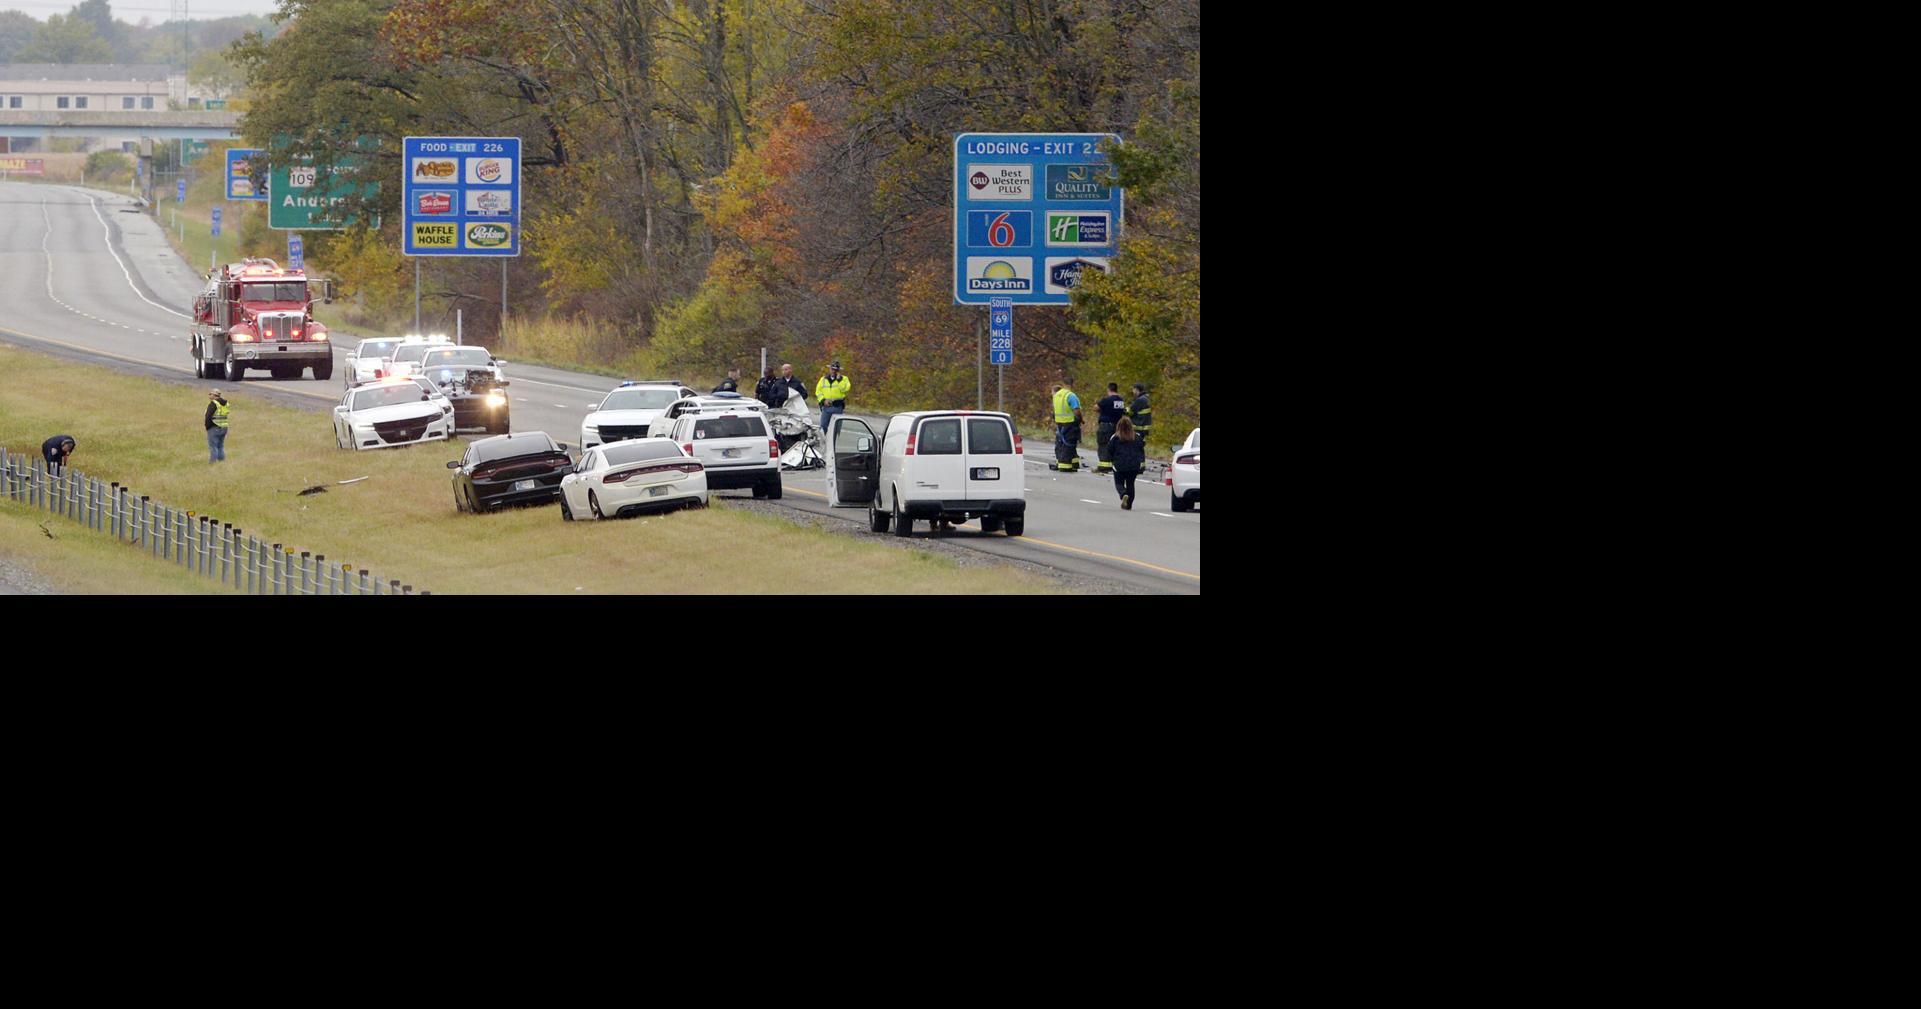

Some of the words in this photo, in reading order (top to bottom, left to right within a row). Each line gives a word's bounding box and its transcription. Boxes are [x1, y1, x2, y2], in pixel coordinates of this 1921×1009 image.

[420, 143, 447, 152] FOOD
[455, 143, 476, 152] EXIT
[483, 143, 504, 152] 226
[967, 142, 1029, 154] LODGING
[1044, 142, 1074, 154] EXIT
[1082, 142, 1102, 154] 22
[481, 167, 501, 177] KING
[1001, 169, 1022, 178] Best
[291, 174, 315, 185] 109
[972, 176, 987, 185] BW
[992, 177, 1030, 185] Western
[1055, 181, 1099, 194] QUALITY
[416, 226, 454, 234] WAFFLE
[470, 226, 505, 239] Perkins
[988, 211, 1015, 248] 6
[418, 236, 452, 244] HOUSE
[972, 279, 1003, 290] Days
[1004, 279, 1026, 289] Inn
[991, 299, 1011, 308] SOUTH
[995, 314, 1008, 323] 69
[992, 329, 1011, 338] MILE
[992, 338, 1011, 349] 228
[996, 352, 1006, 362] .0
